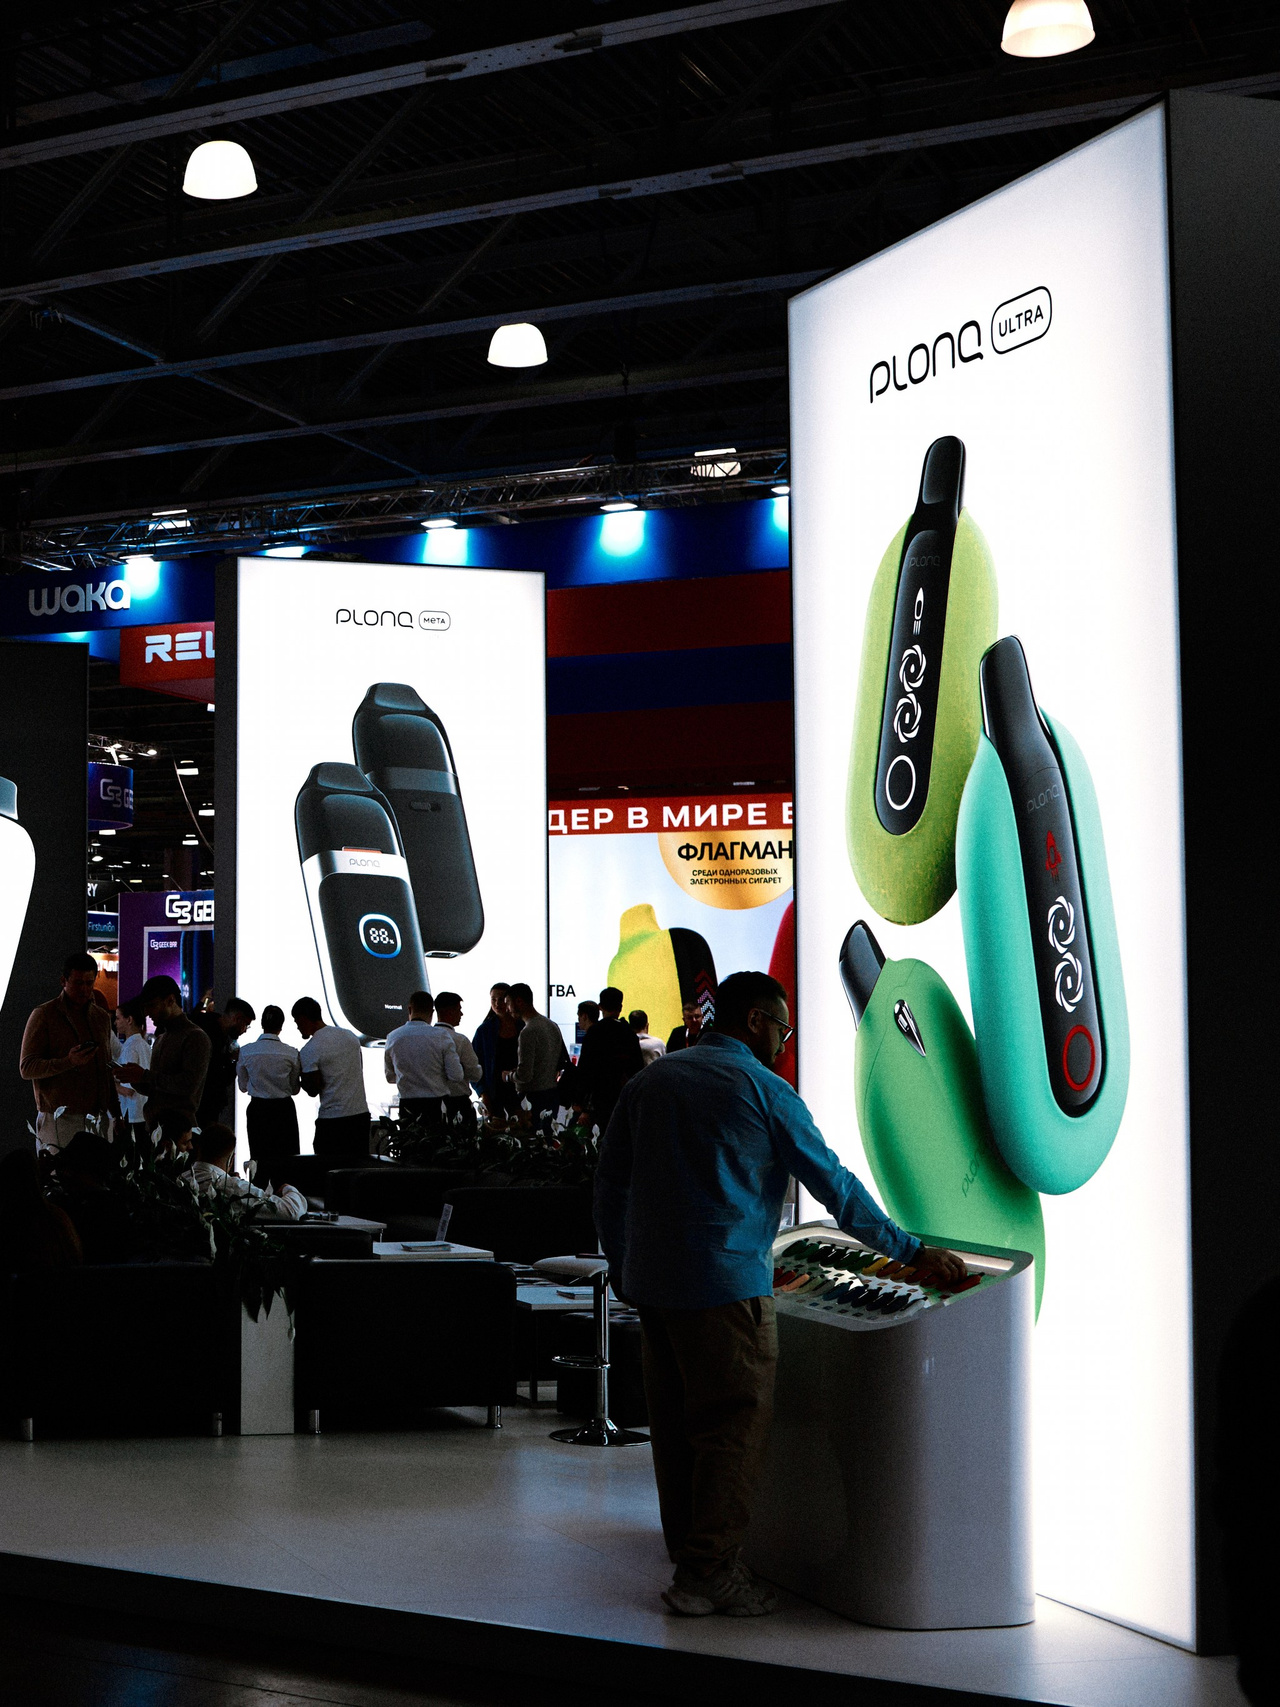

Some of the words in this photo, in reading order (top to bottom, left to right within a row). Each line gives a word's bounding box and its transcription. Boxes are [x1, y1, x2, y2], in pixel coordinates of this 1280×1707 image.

[998, 305, 1044, 337] ULTRA
[628, 806, 649, 828] В
[663, 802, 767, 828] МИРЕ
[677, 840, 793, 861] ФЛАГМАН
[692, 869, 718, 877] СРЕДИ
[718, 868, 778, 877] ОДНОРАЗОВЫХ
[748, 876, 782, 884] СИГАРЕТ
